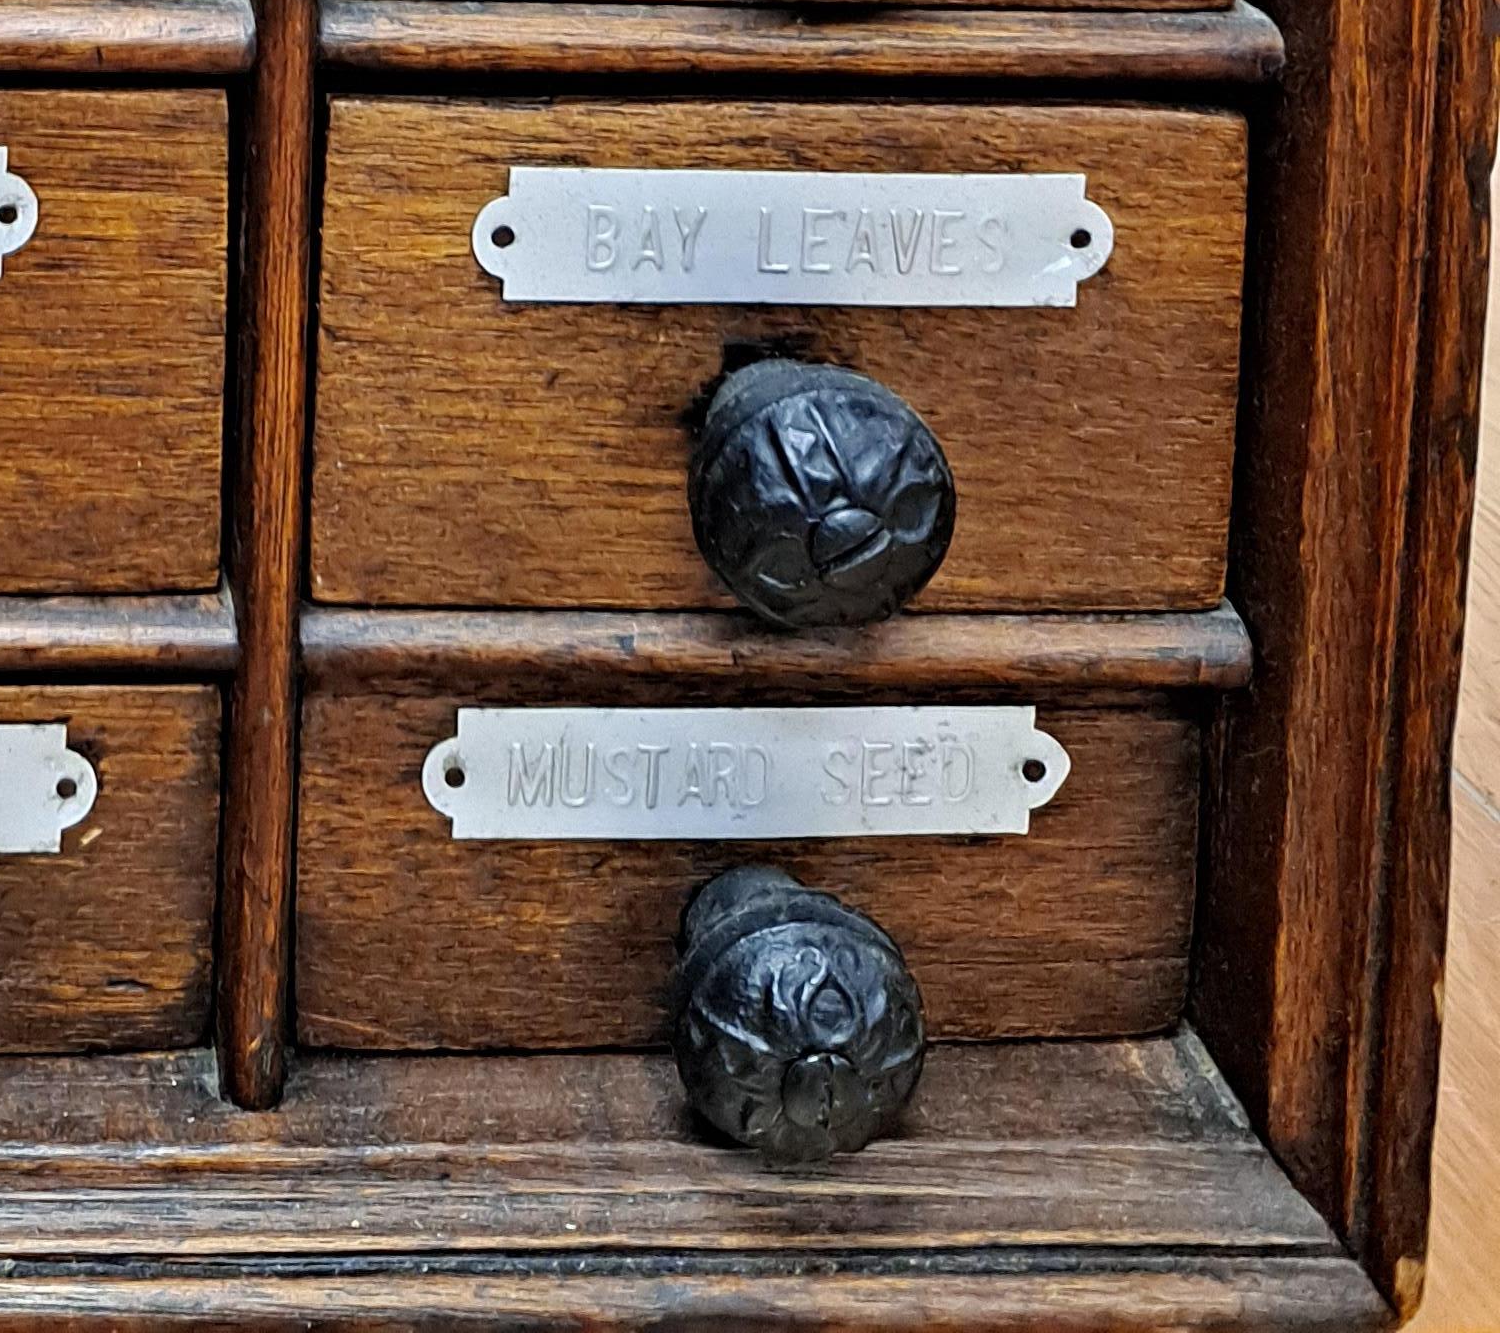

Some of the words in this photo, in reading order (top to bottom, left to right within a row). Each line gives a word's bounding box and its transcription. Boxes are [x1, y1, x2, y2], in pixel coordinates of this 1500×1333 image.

[585, 204, 709, 274] BAY
[756, 206, 1008, 277] LEAVES
[507, 741, 773, 809] MUSTARD
[819, 739, 978, 808] SEED
